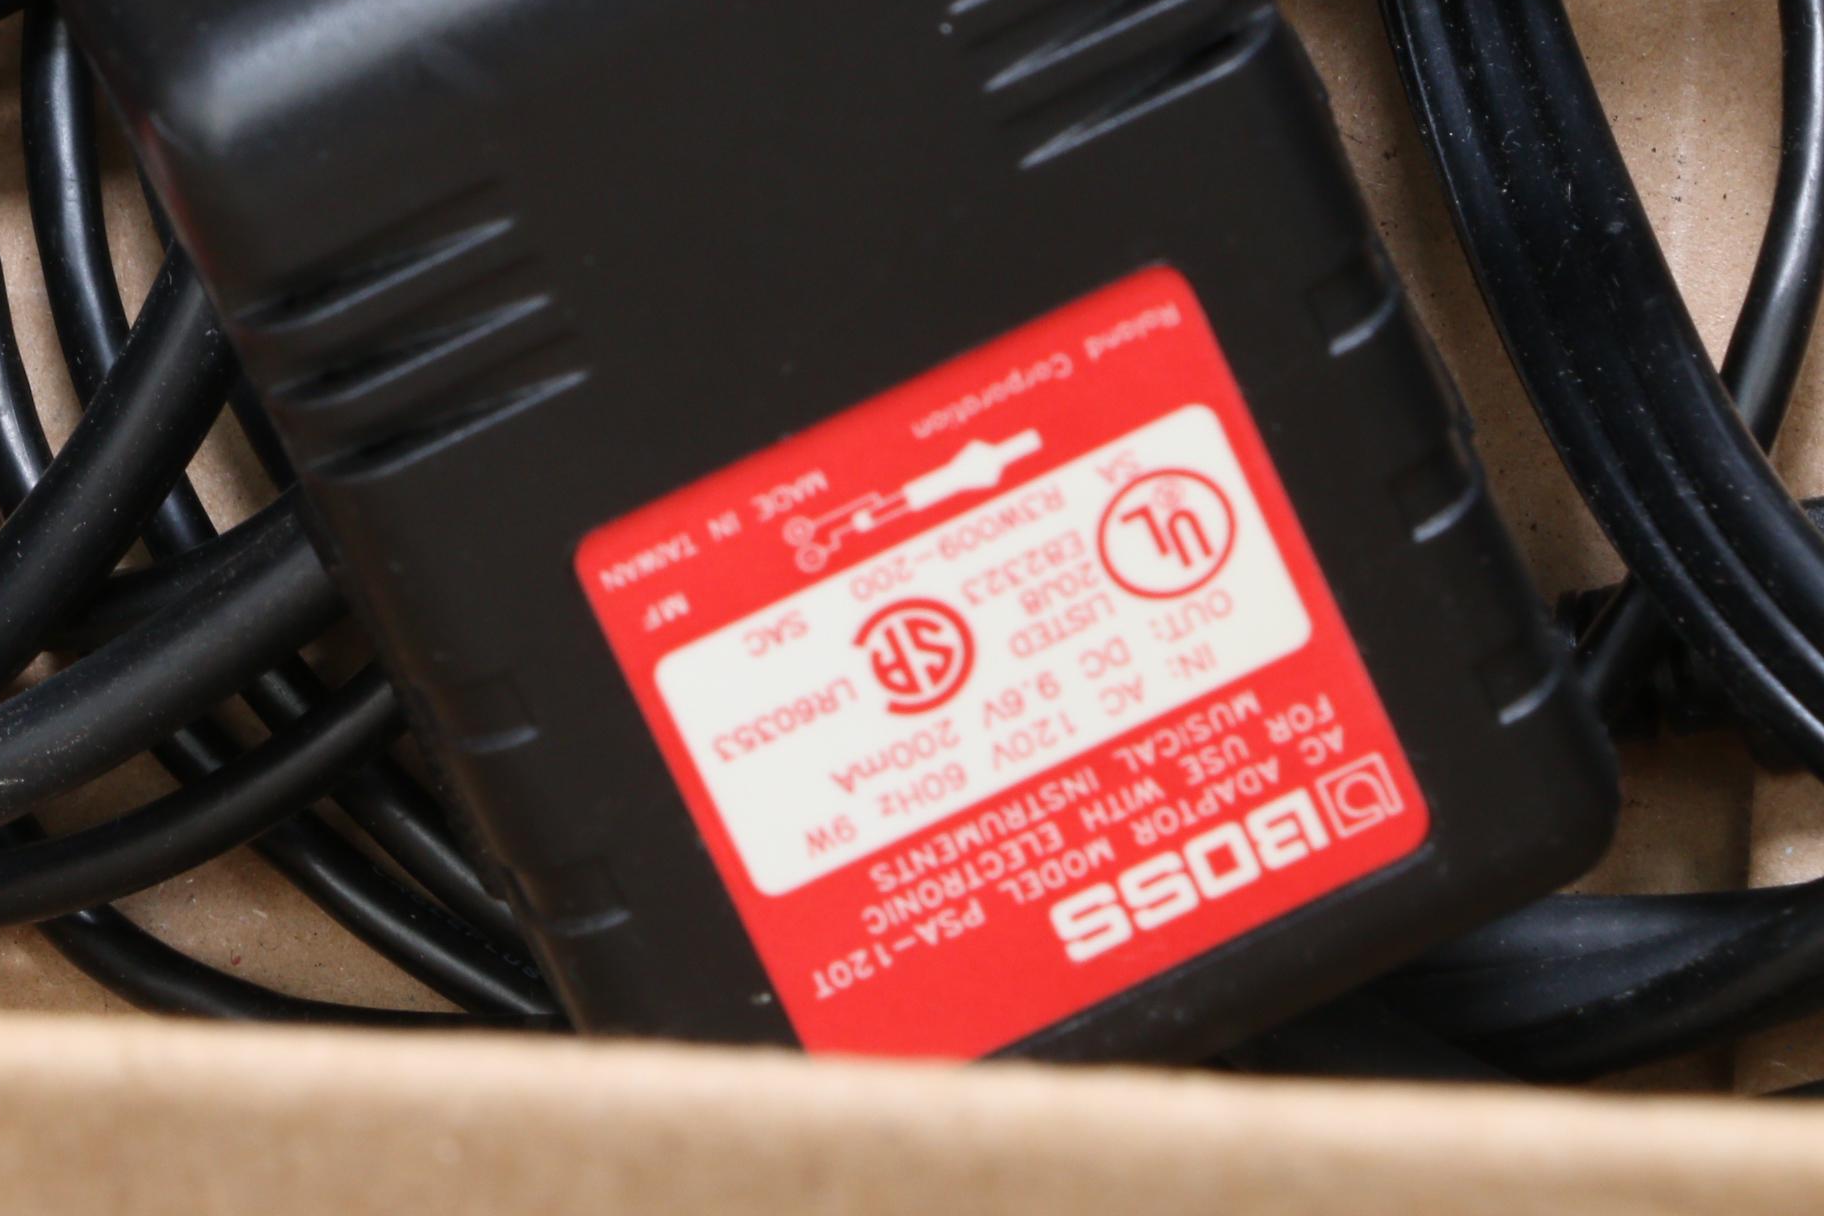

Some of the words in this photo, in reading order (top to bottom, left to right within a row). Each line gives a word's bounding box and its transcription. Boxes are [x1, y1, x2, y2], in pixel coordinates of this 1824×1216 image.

[1083, 302, 1181, 360] Roland
[910, 351, 1073, 439] Corporation
[752, 470, 828, 520] MADE
[707, 511, 740, 539] IN
[599, 534, 697, 588] TAIWAN
[745, 611, 808, 656] SAC
[1008, 591, 1115, 659] LISTED
[1148, 587, 1234, 644] OUT:
[1078, 635, 1132, 680] DC
[1163, 642, 1217, 685] IN:
[982, 670, 1061, 727] 9.6V
[1098, 675, 1145, 717] AC
[1264, 693, 1334, 744] FOR
[830, 718, 959, 794] 200mA
[990, 712, 1077, 770] 120V
[1113, 690, 1261, 771] MUSICAL
[1298, 724, 1344, 766] AC
[1178, 734, 1249, 785] USE
[876, 761, 968, 817] 60Hz
[1079, 776, 1165, 830] WITH
[1129, 756, 1279, 846] ADAPTOR
[805, 816, 855, 852] 9W
[868, 767, 1099, 893] INSTRUMENTS
[861, 820, 1064, 934] ELECTRONIC
[997, 836, 1115, 903] MODEL
[1048, 787, 1329, 962] BOSS
[812, 896, 986, 999] PSA-120T
